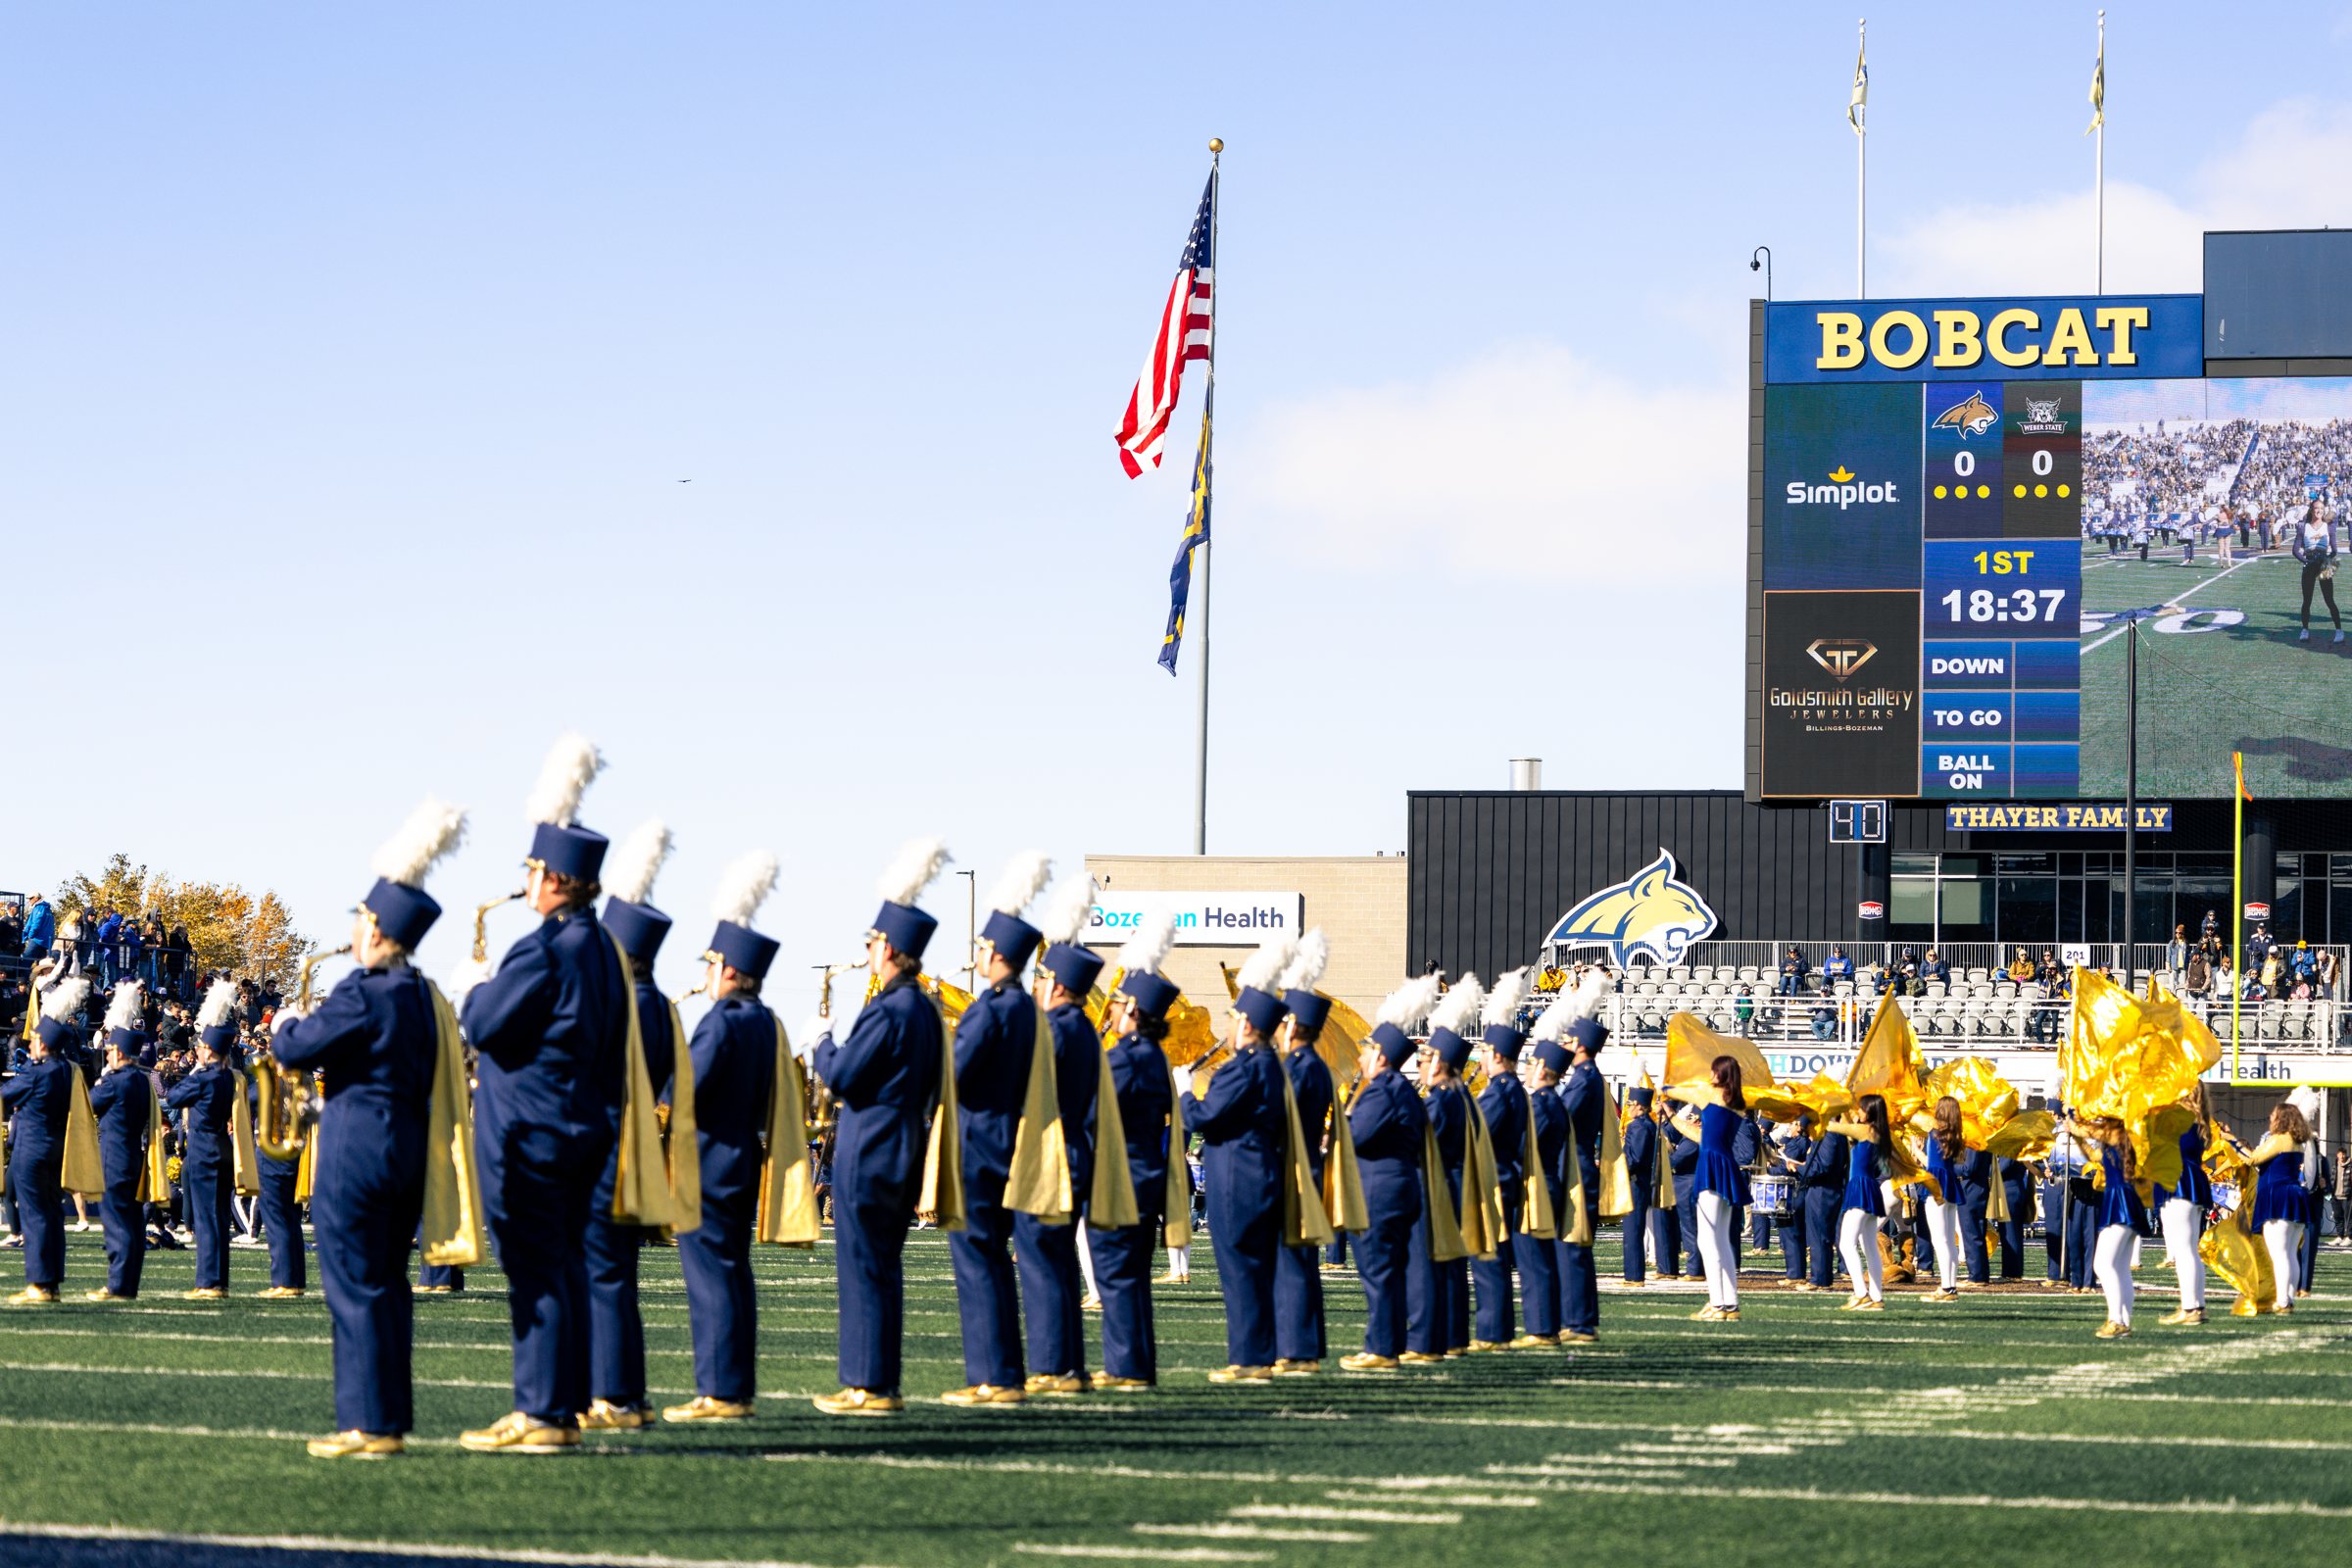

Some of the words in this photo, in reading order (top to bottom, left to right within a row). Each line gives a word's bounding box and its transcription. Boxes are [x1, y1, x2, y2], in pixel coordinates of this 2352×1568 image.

[1816, 307, 2148, 369] BOBCAT
[1954, 451, 1976, 477] 0
[2032, 450, 2053, 476] 0
[1787, 481, 1898, 510] Simplot
[1973, 551, 2034, 574] 1ST
[1941, 589, 2066, 622] 18:37
[1932, 658, 2004, 674] DOWN
[1770, 687, 1852, 707] Goldsmith
[1857, 687, 1914, 711] Gallery
[1789, 710, 1894, 720] JEWELERS
[1933, 710, 1964, 726] TO
[1969, 710, 2002, 726] GO
[1938, 755, 1995, 771] BALL
[1949, 773, 1983, 790] ON
[1835, 804, 1881, 838] 40
[1949, 807, 2059, 828] THAYER
[2067, 807, 2168, 828] FAMLY
[1090, 906, 1197, 928] Bozean
[1204, 906, 1284, 928] Health
[2066, 951, 2084, 959] 201
[2220, 1061, 2291, 1079] Health
